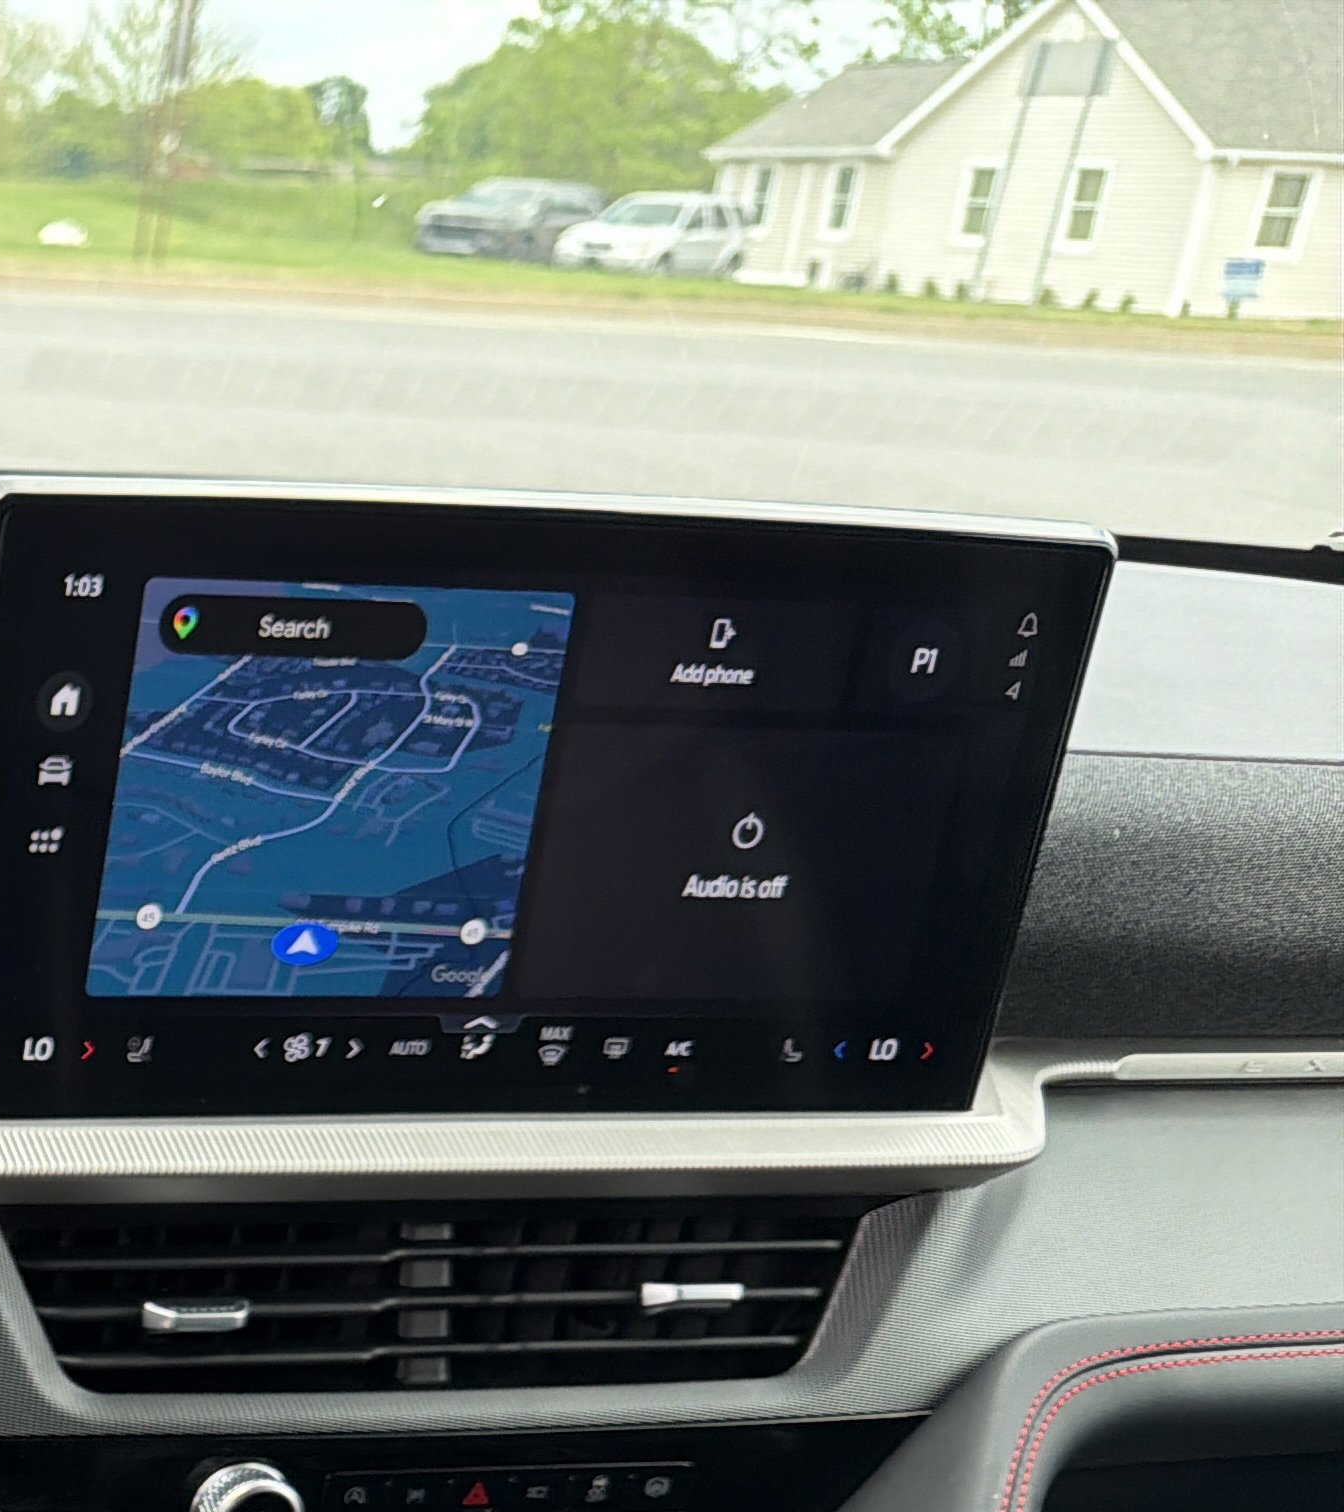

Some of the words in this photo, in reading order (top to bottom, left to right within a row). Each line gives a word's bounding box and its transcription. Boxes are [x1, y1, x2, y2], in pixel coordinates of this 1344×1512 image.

[64, 573, 104, 597] 1:03
[258, 614, 330, 639] Search
[910, 648, 939, 673] P1
[670, 663, 705, 684] Add
[703, 664, 755, 686] phone
[681, 874, 739, 898] Audio
[739, 875, 757, 898] is
[757, 875, 789, 899] off
[431, 963, 486, 987] Goog
[539, 1025, 573, 1041] MAX
[22, 1036, 56, 1061] LO
[388, 1038, 432, 1056] AUTO
[867, 1037, 899, 1061] LO
